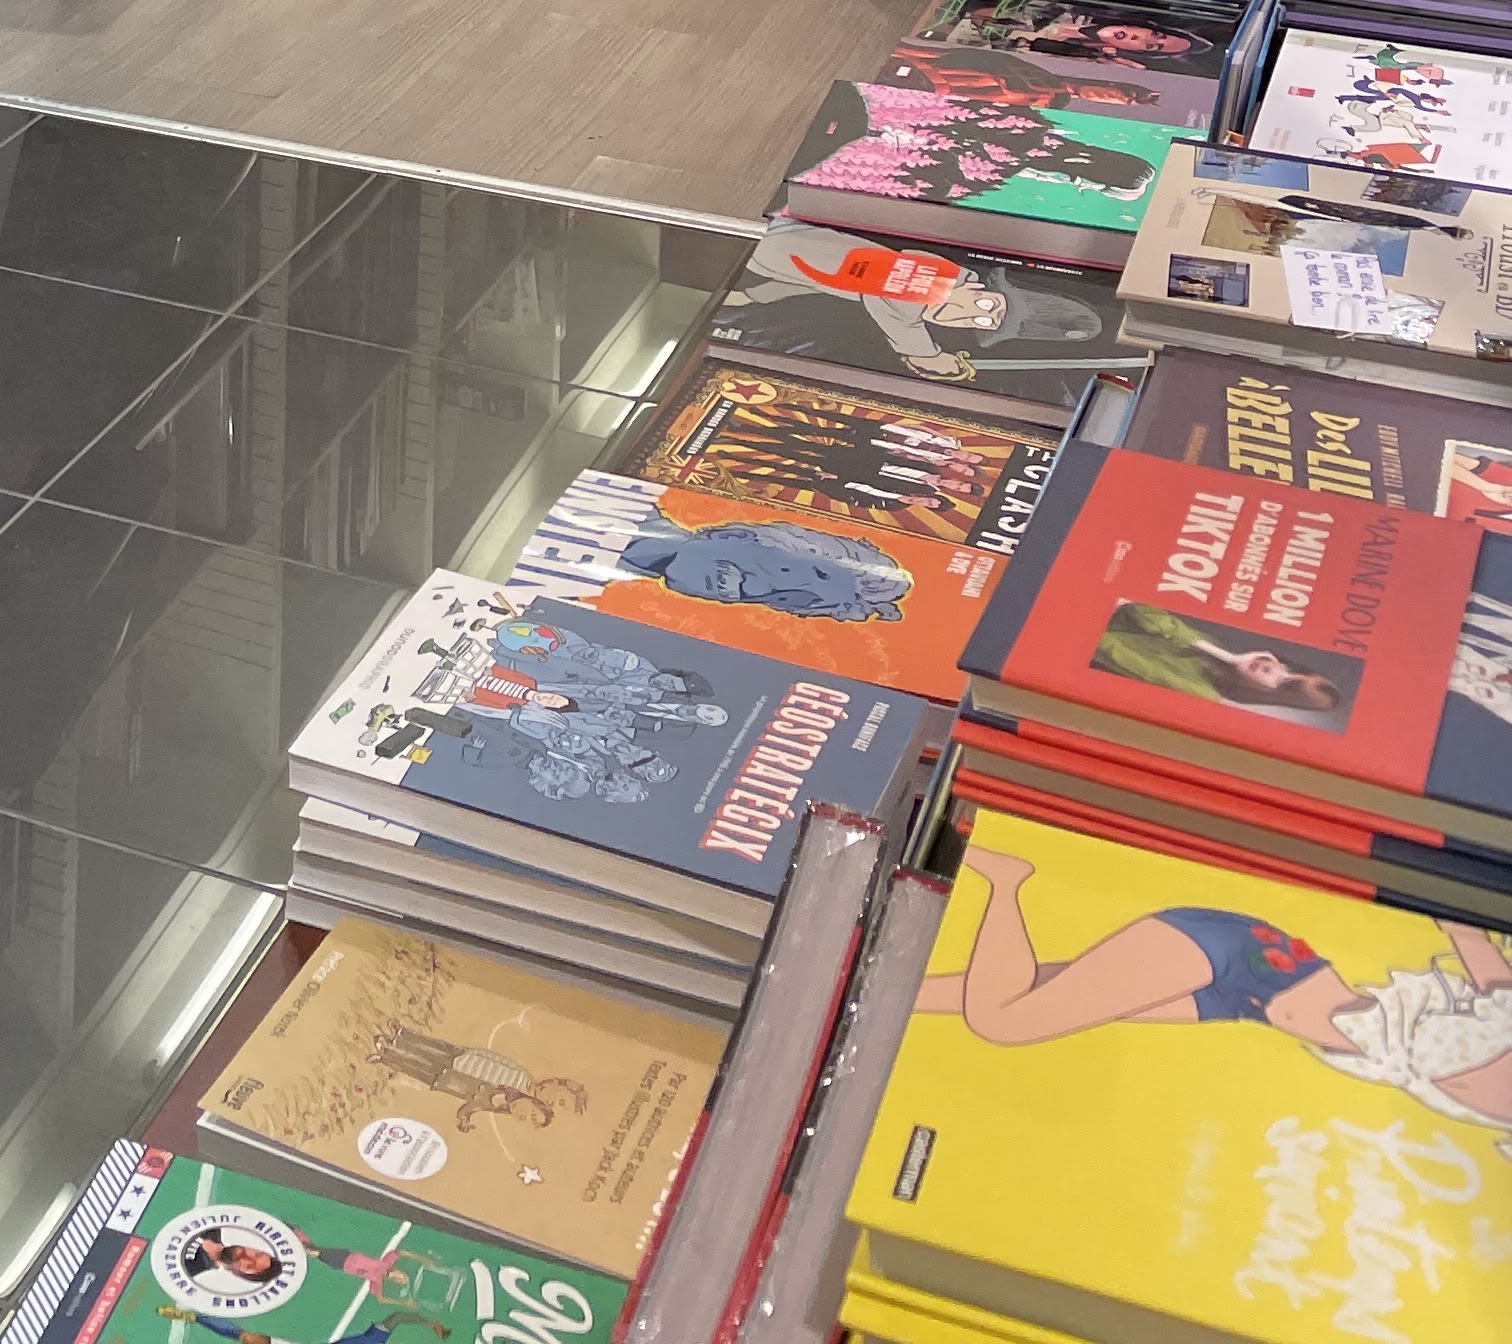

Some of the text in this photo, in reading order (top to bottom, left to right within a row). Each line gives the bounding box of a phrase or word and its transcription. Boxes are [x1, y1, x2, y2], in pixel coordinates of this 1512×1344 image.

[1157, 492, 1245, 605] TIKTOK
[1223, 500, 1284, 614] D'ABONNÉS SUR
[1262, 512, 1334, 630] 1 MILLION
[698, 681, 849, 864] GÉOSTRATÉGIX
